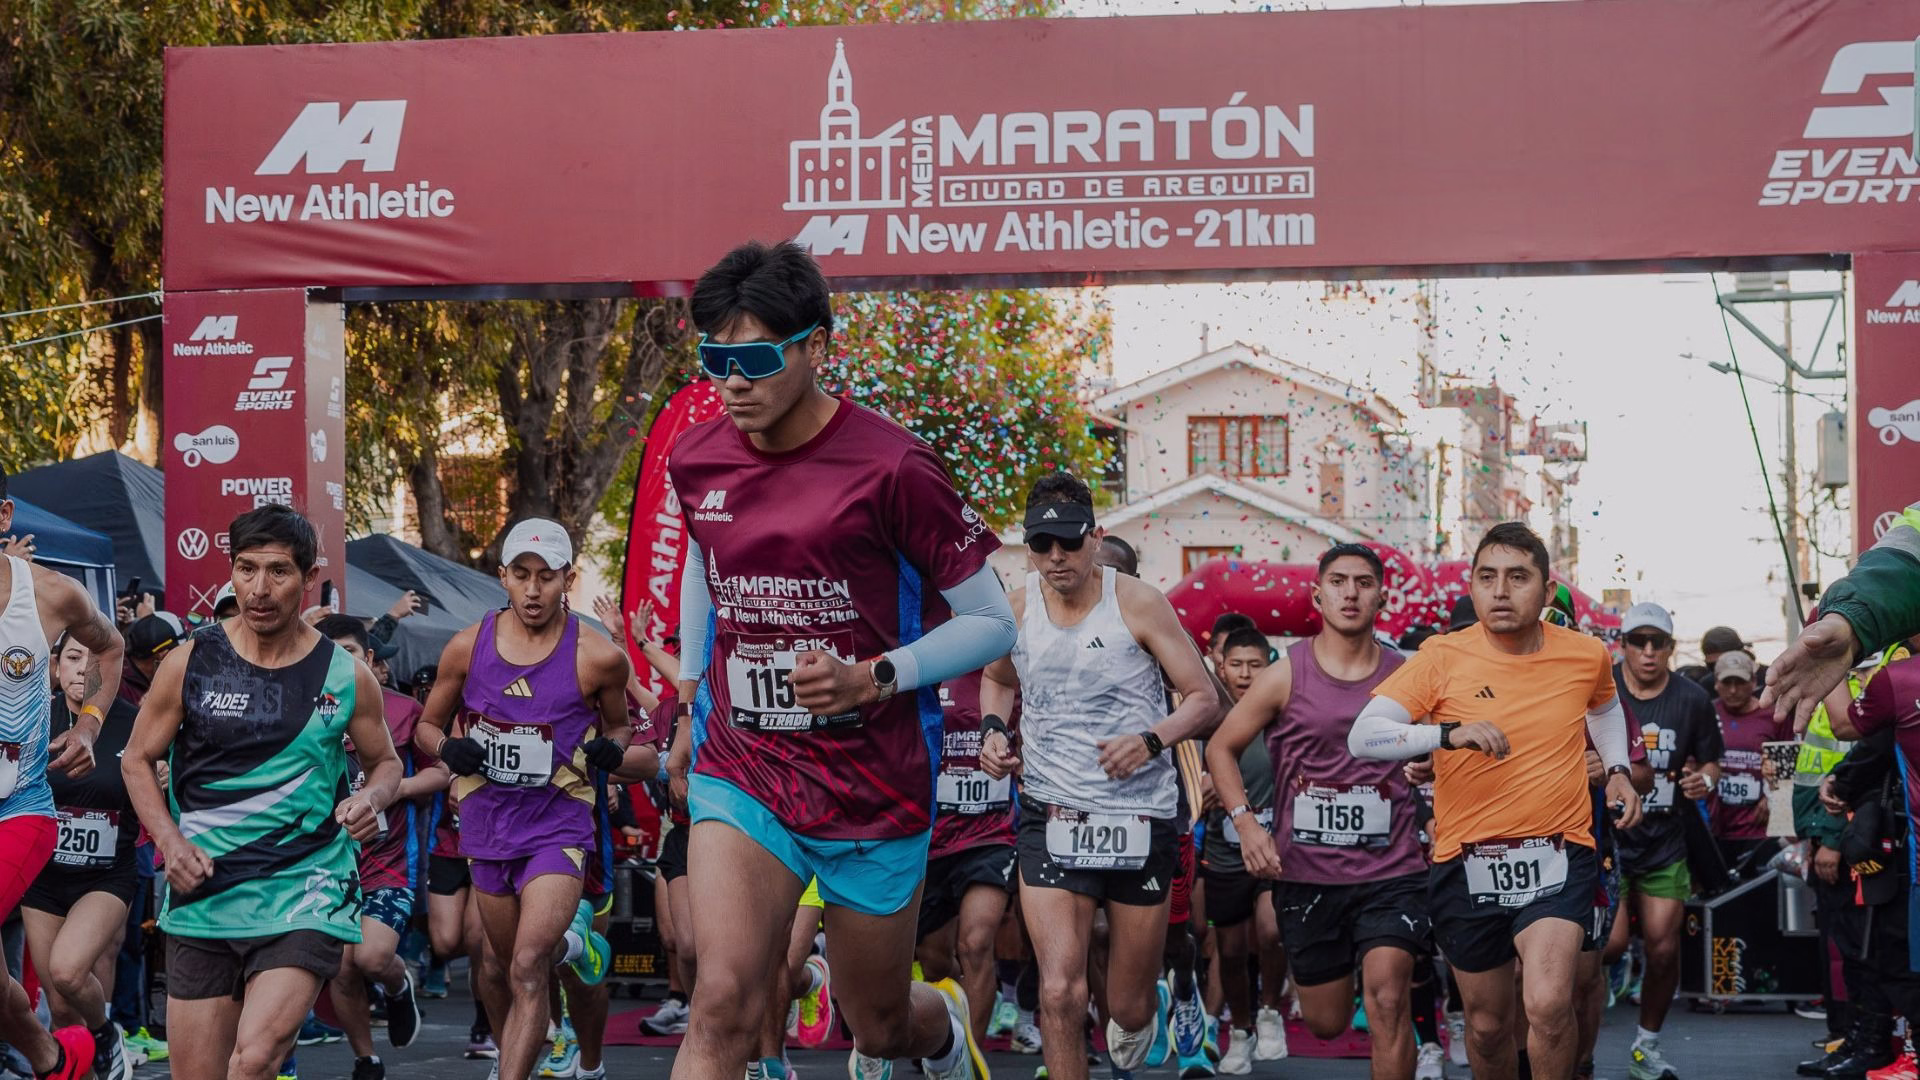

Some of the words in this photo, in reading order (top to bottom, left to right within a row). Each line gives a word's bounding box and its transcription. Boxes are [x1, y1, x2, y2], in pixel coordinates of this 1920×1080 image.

[939, 91, 1314, 167] MARATÓN
[911, 115, 933, 208] MEDIA
[950, 179, 1065, 200] CIUDAD
[1084, 178, 1124, 198] DE
[1143, 174, 1306, 196] AREQUIPA
[1758, 177, 1920, 206] SPORT
[205, 186, 294, 224] New
[300, 180, 455, 221] Athletic
[887, 213, 987, 255] New
[994, 208, 1169, 252] Athletic
[1867, 308, 1901, 324] New
[173, 342, 203, 357] New
[204, 340, 254, 356] Athletic
[237, 390, 296, 401] EVENT
[234, 400, 293, 412] SPORTS
[1890, 411, 1915, 422] san
[192, 437, 214, 446] san
[215, 435, 235, 446] luis
[221, 477, 292, 496] POWER
[705, 511, 733, 522] Athletic
[740, 575, 850, 599] MARATÓN
[735, 607, 759, 623] New
[762, 609, 812, 627] Athletic
[794, 637, 830, 651] 21K
[746, 668, 797, 709] 115
[212, 709, 243, 718] RUNNING
[759, 713, 813, 727] STRADA
[513, 726, 538, 735] 21K
[484, 739, 521, 770] 1115
[956, 780, 989, 802] 1101
[1721, 781, 1748, 797] 1436
[85, 811, 107, 820] 21K
[1315, 803, 1365, 831] 1158
[57, 826, 100, 854] 250
[1069, 826, 1127, 854] 1420
[1522, 836, 1550, 849] 21K
[1488, 860, 1541, 891] 1391
